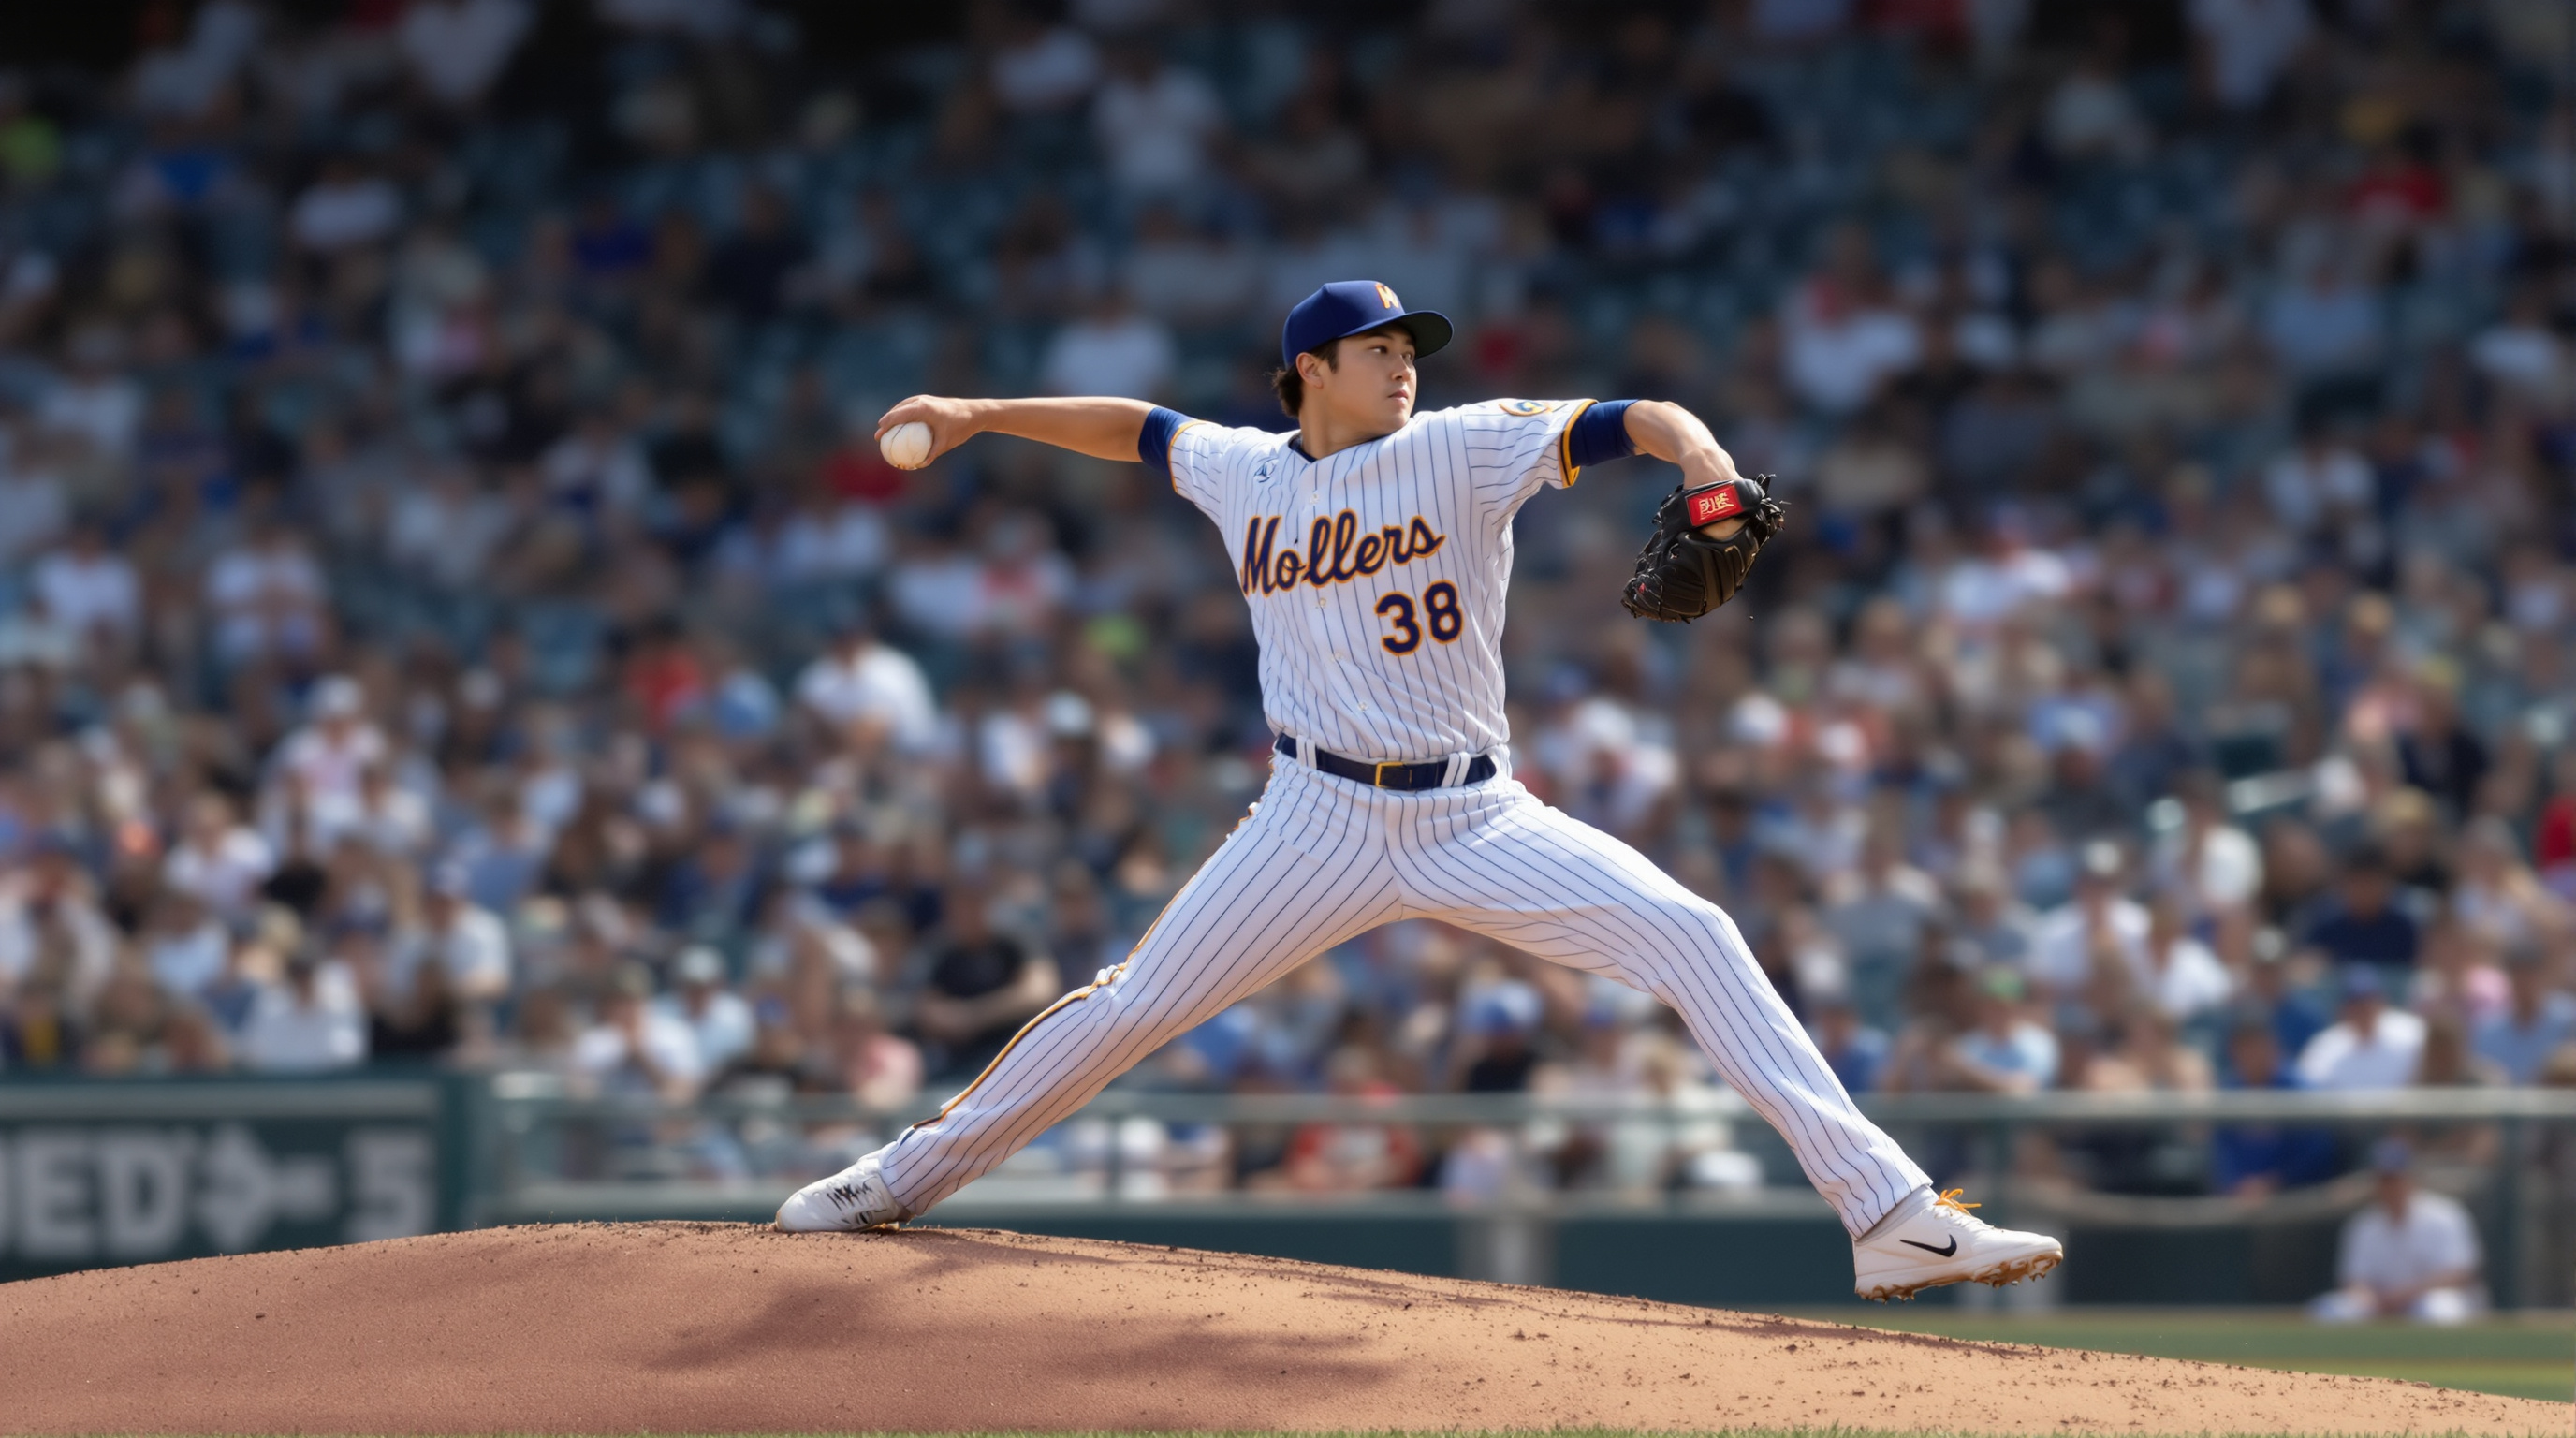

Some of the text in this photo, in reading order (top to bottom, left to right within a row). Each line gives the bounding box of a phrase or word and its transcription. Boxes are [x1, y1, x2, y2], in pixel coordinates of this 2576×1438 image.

[1240, 508, 1446, 597] Mollers
[1374, 579, 1463, 655] 38
[0, 1130, 182, 1255] ED
